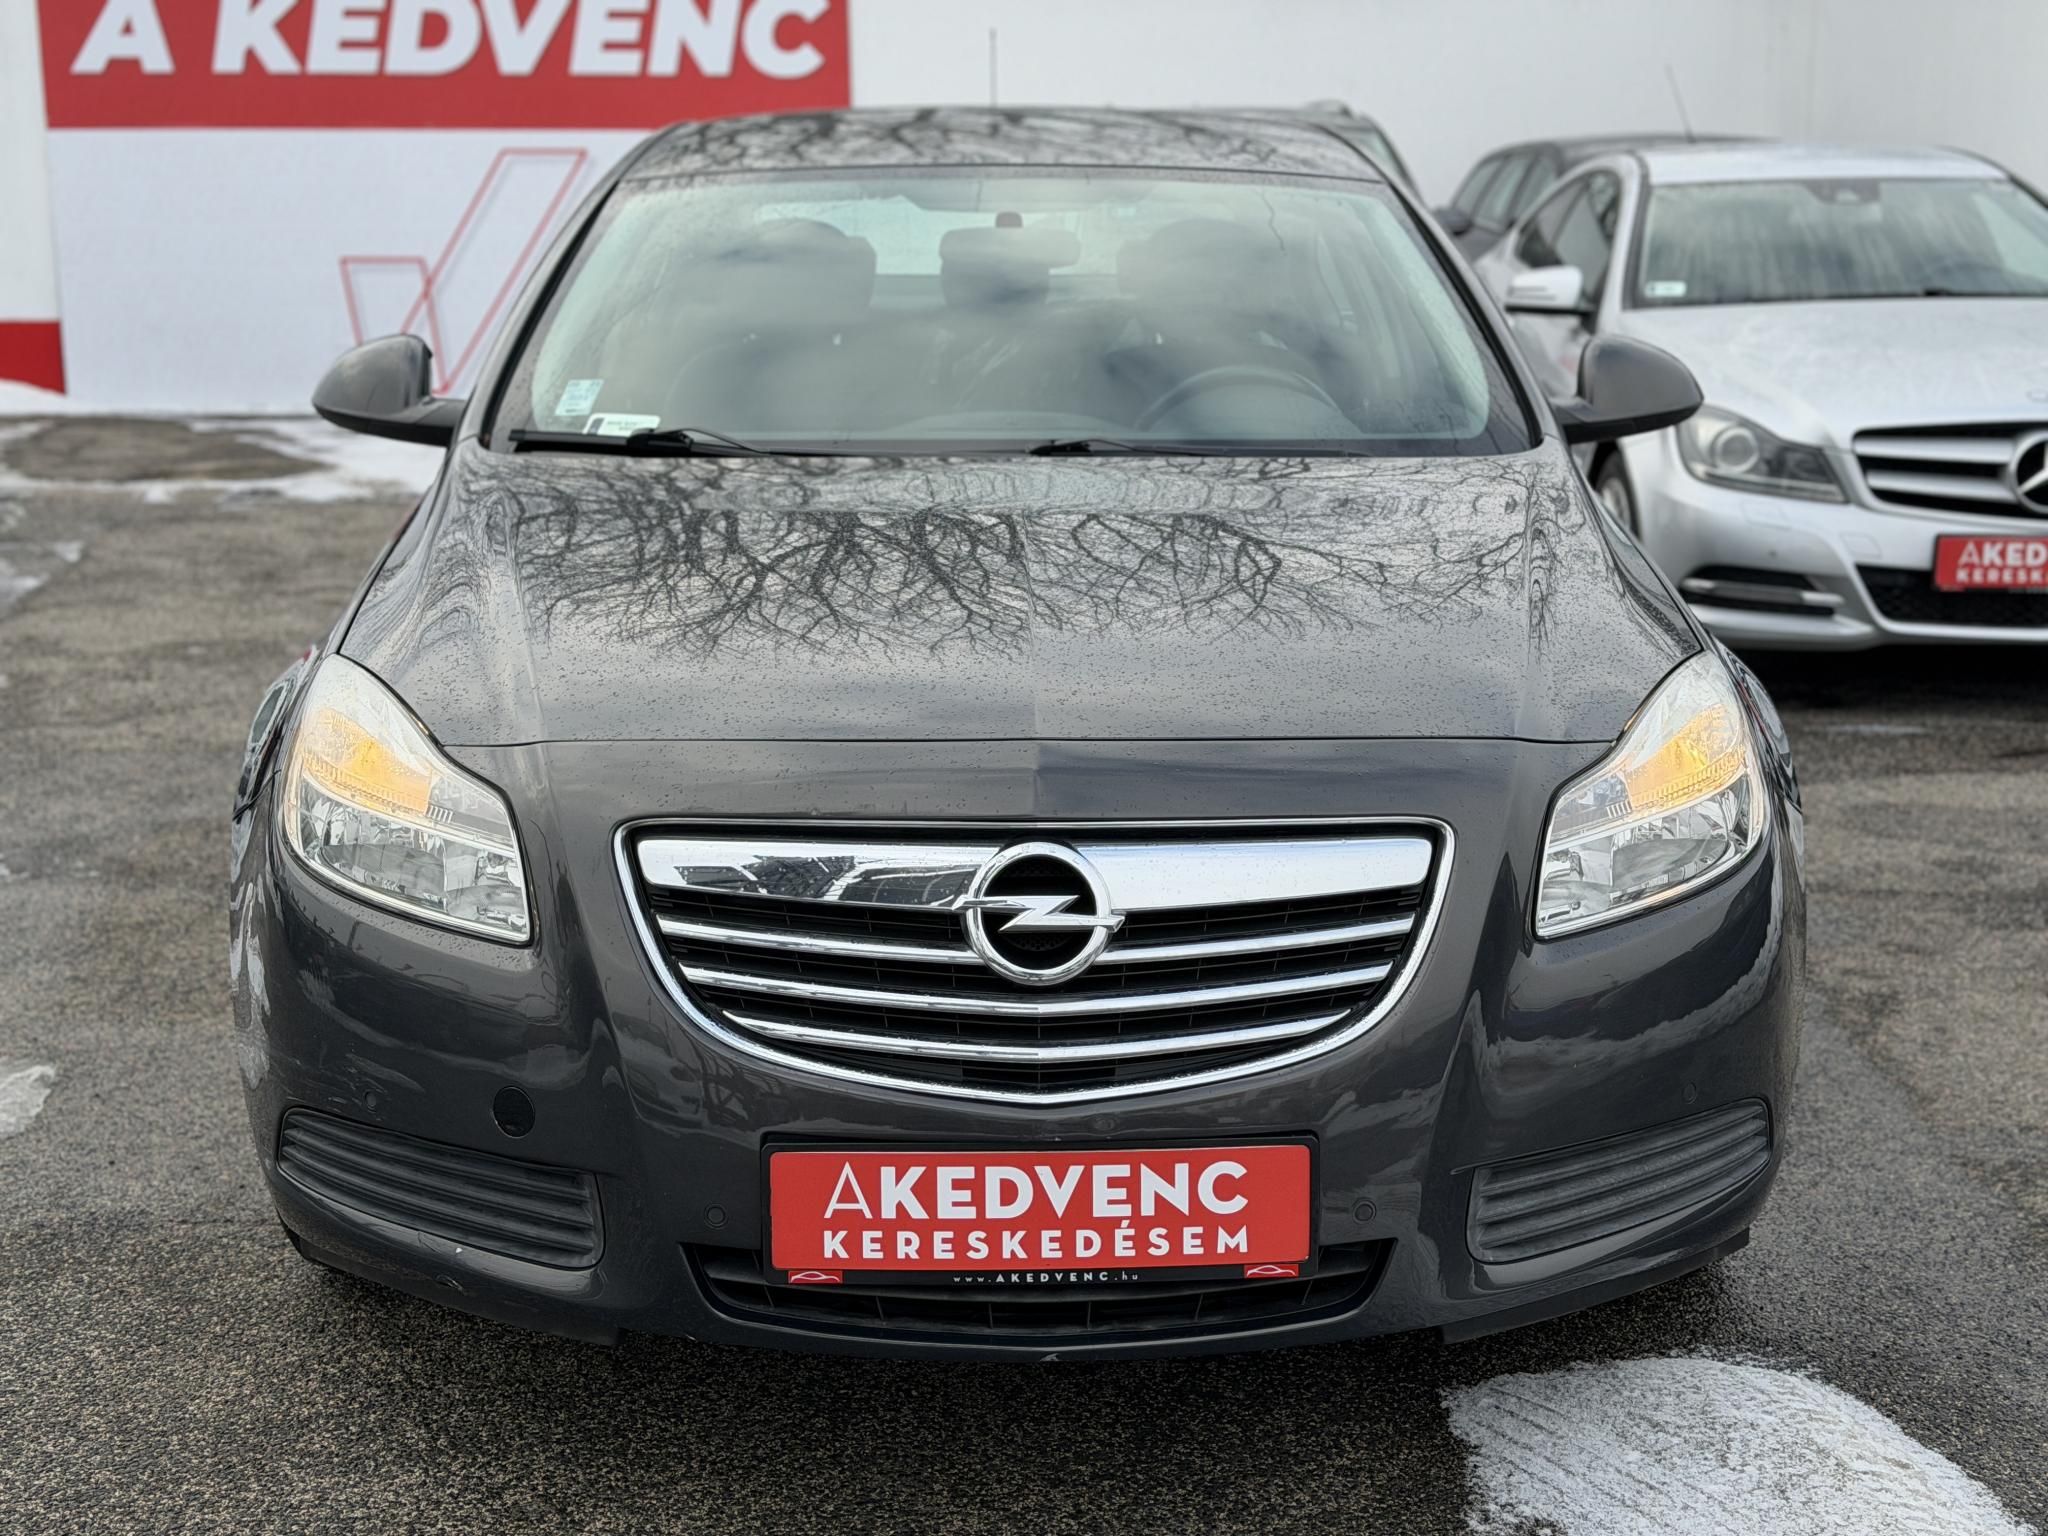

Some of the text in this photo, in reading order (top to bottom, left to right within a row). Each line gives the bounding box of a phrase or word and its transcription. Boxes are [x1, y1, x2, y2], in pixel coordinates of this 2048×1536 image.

[69, 0, 831, 80] A KEDVENC
[823, 1219, 1249, 1261] KERESKEDÉSEM
[953, 1271, 1138, 1283] www.AKEDVENC.hu
